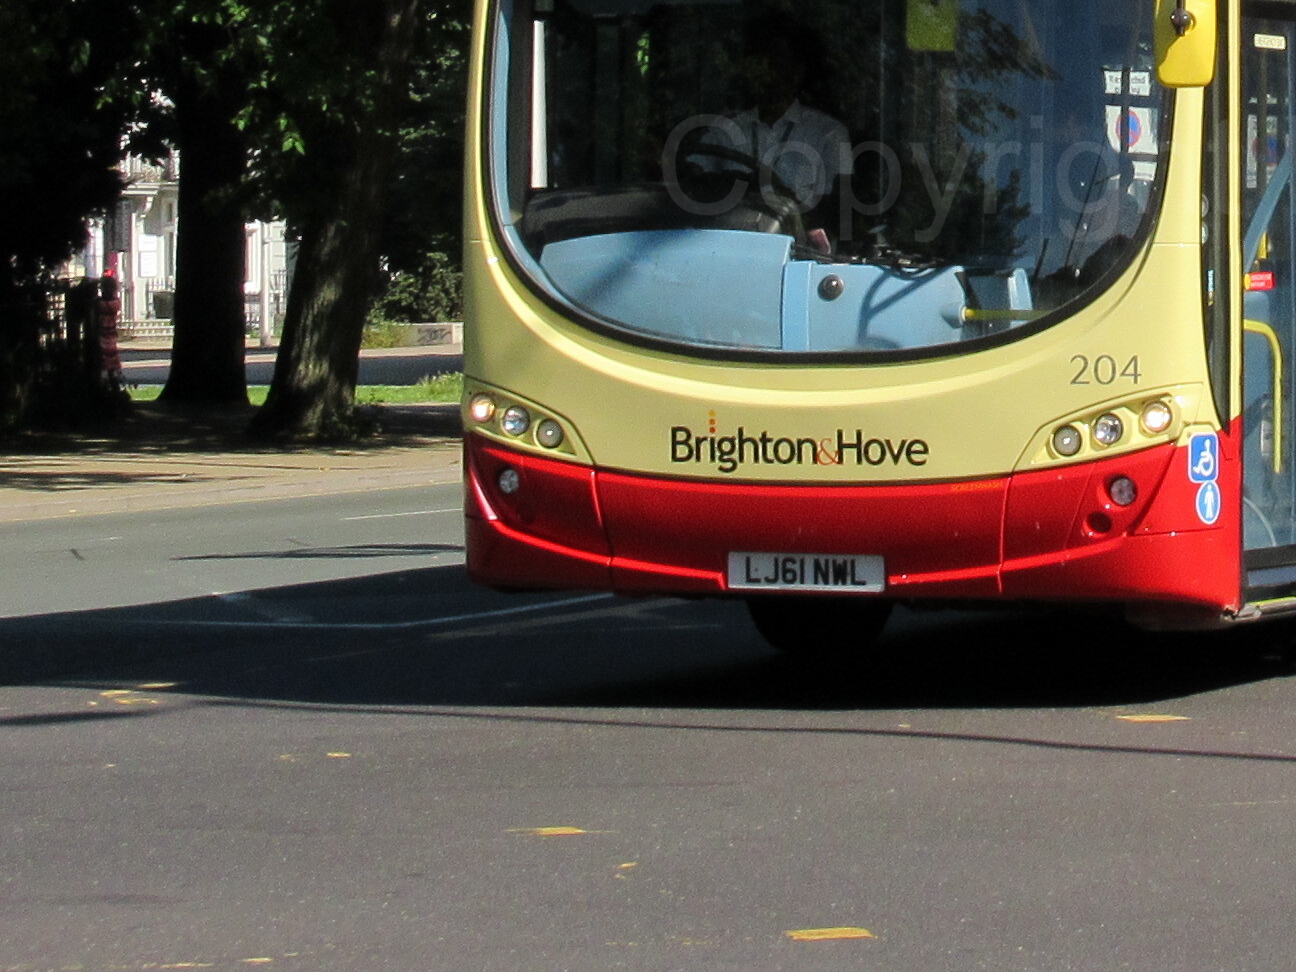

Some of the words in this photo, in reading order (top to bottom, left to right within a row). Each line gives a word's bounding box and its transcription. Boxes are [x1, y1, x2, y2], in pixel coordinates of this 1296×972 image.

[1069, 354, 1142, 385] 204
[670, 411, 930, 473] Brighton&Hove
[744, 556, 805, 586] LJ61
[812, 556, 867, 587] NWL
